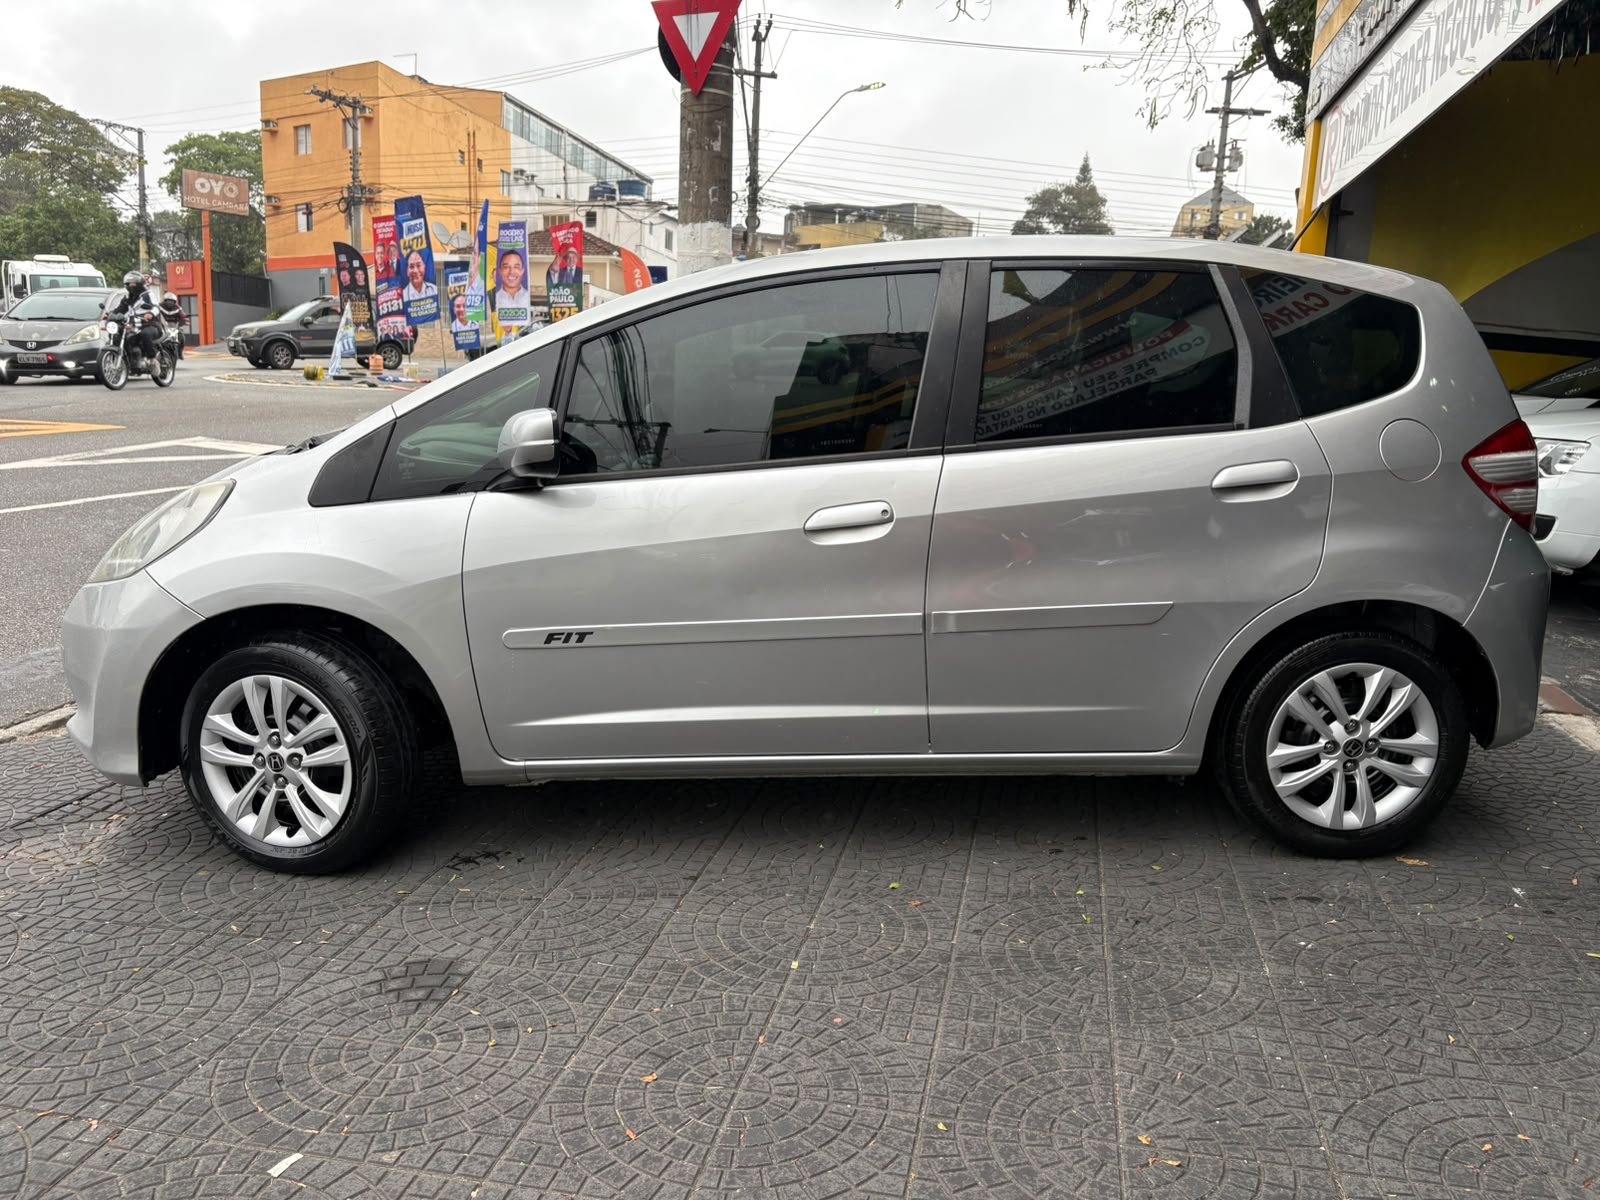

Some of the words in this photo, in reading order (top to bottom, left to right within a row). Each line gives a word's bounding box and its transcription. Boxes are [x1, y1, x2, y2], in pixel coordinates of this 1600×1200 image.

[1384, 25, 1432, 130] PERDER
[194, 177, 239, 199] OYO
[183, 195, 210, 206] HOTEL
[549, 286, 570, 296] JOÃO
[550, 295, 575, 303] PAULO
[378, 299, 404, 316] 13131
[543, 631, 594, 645] FIT
